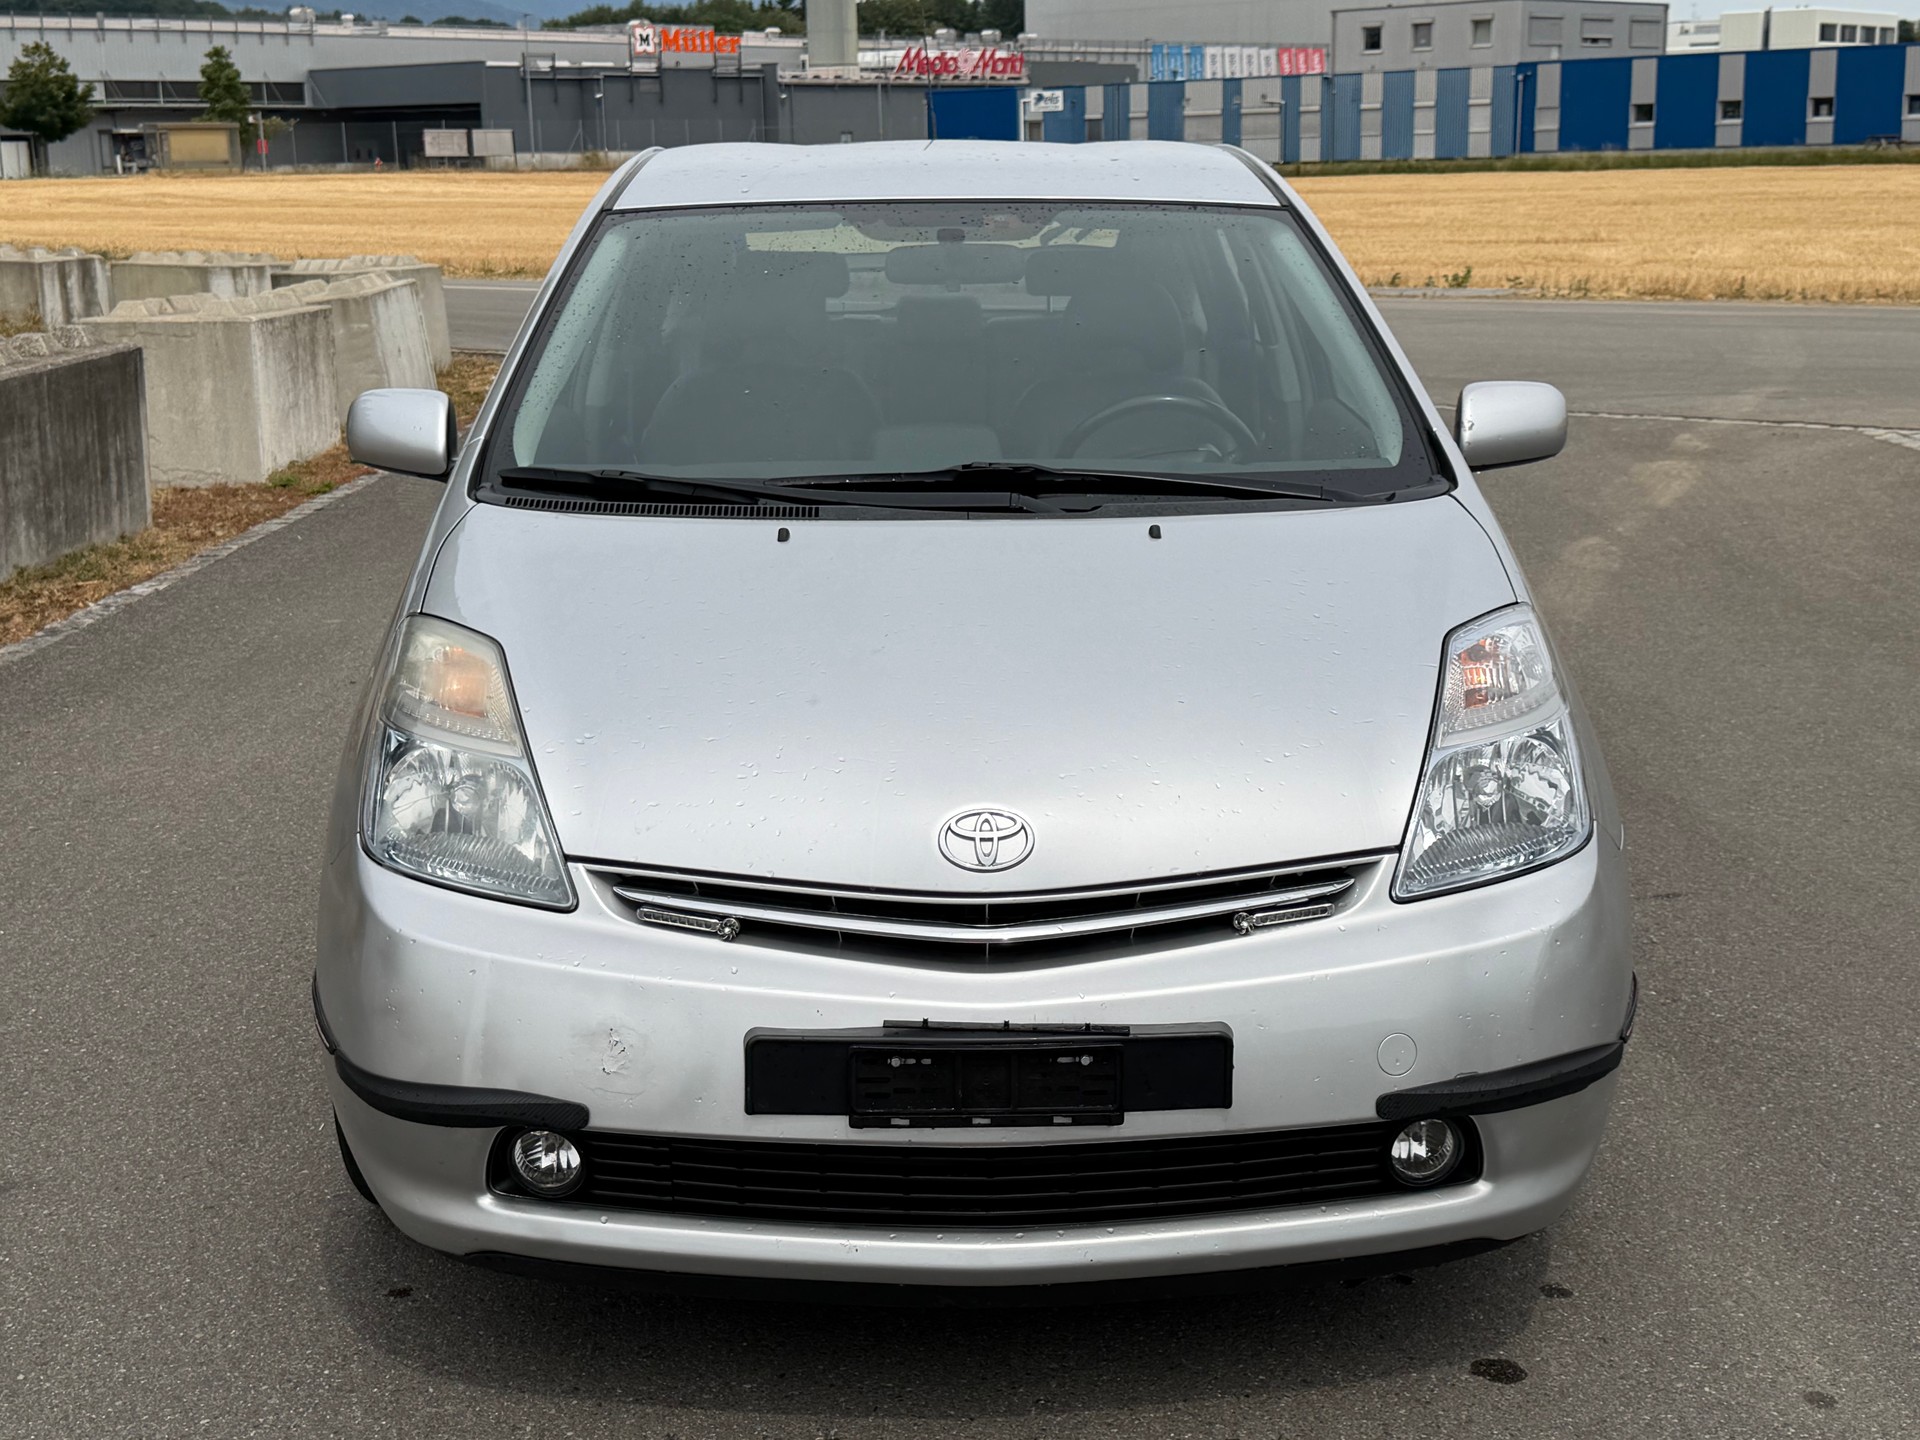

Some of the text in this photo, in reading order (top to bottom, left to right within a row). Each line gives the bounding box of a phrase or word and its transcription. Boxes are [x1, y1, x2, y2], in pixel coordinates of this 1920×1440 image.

[639, 33, 650, 47] M
[660, 27, 741, 54] Müller
[895, 46, 1025, 75] Media Markt
